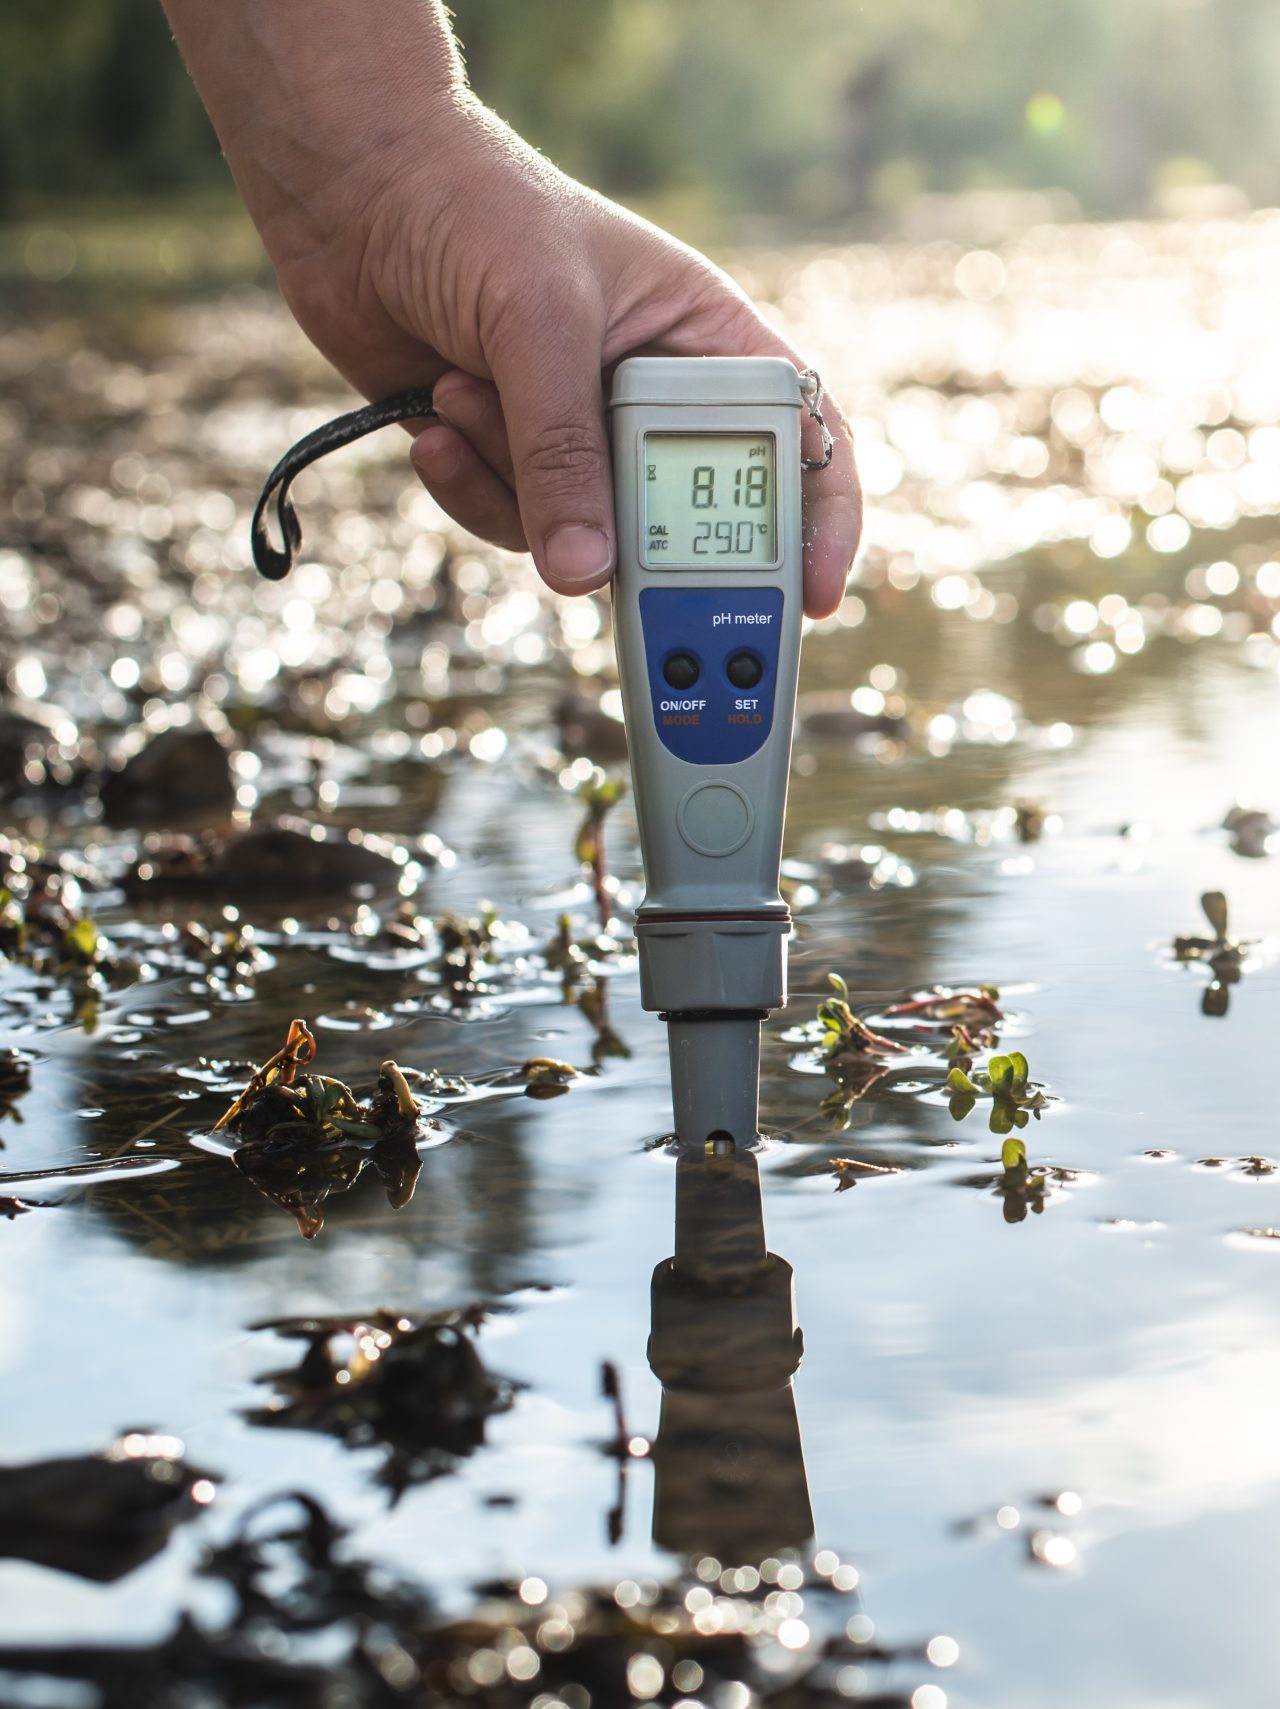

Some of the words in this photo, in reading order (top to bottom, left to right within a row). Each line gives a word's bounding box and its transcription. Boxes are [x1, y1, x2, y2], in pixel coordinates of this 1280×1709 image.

[749, 446, 766, 458] pH
[692, 466, 768, 509] 8.18
[649, 525, 669, 536] CAL
[693, 521, 754, 554] 29.0
[649, 539, 669, 551] ATC
[712, 612, 732, 627] pH
[734, 613, 773, 625] meter
[660, 700, 707, 711] ON/OFF
[735, 699, 759, 710] SET
[663, 714, 701, 726] MODE
[727, 713, 763, 724] HOLD
